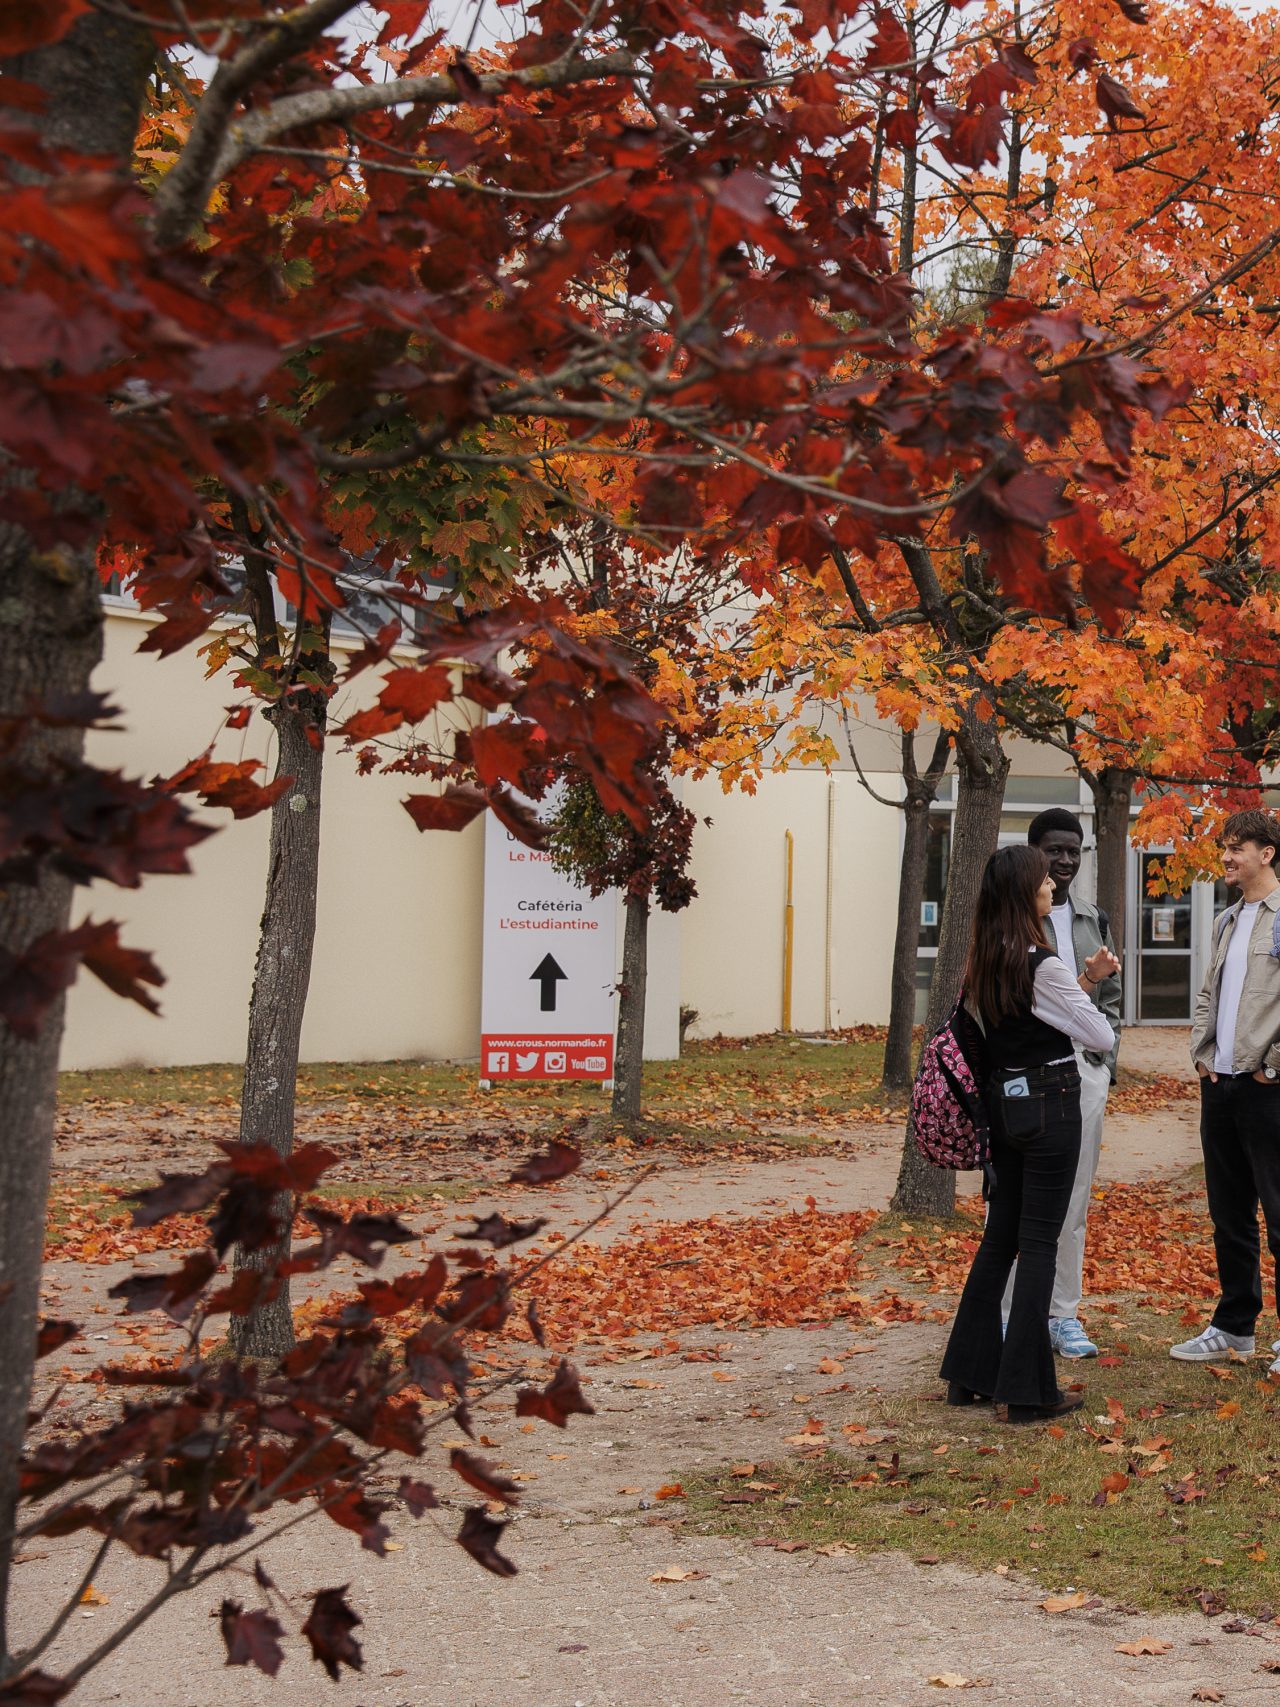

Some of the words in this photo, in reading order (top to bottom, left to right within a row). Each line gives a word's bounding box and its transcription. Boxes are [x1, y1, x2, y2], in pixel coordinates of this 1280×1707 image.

[509, 851, 525, 862] Le
[517, 900, 583, 912] Cafétéria
[500, 918, 599, 930] L'estudiantine
[488, 1038, 607, 1048] www.crous.normandie.fr
